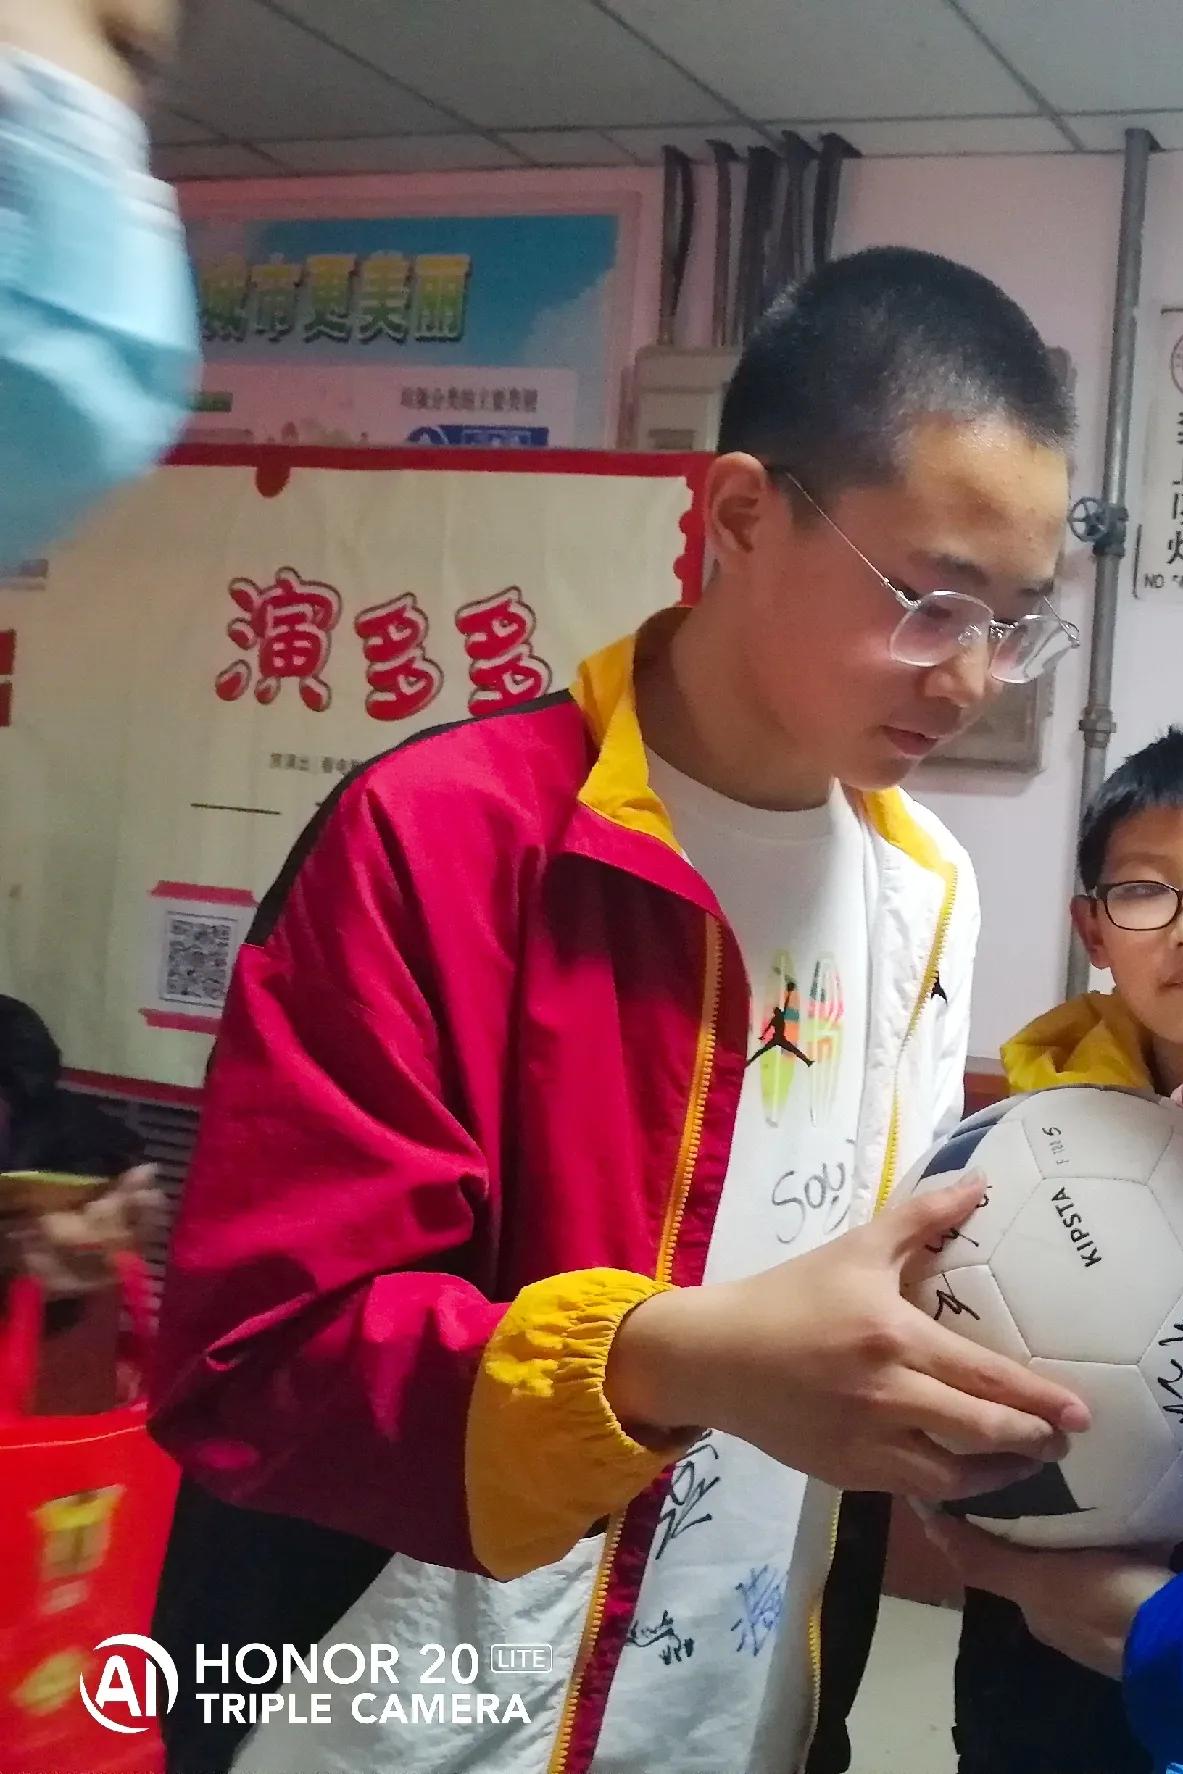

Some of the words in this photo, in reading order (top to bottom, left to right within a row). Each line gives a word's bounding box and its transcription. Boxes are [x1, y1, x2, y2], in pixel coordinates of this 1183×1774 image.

[1144, 573, 1165, 589] NO
[215, 566, 553, 721] 演多多
[1051, 1186, 1102, 1268] KIPSTA
